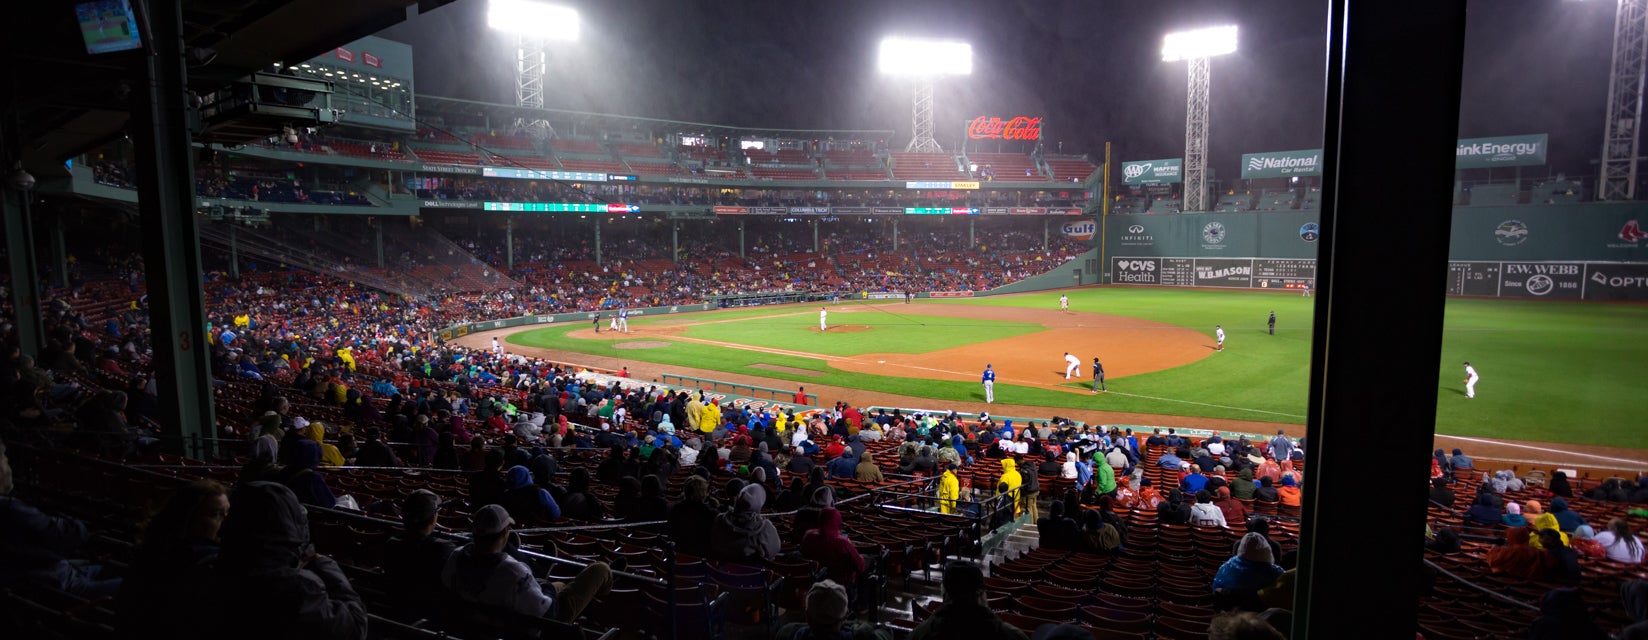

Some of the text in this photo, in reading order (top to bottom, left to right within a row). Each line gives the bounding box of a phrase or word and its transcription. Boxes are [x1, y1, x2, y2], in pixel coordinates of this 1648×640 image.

[1263, 155, 1318, 168] National
[1063, 224, 1094, 233] Gulf
[1130, 260, 1155, 271] CVS
[1534, 265, 1578, 274] WEBB
[1119, 272, 1155, 282] Health
[179, 331, 190, 351] 3
